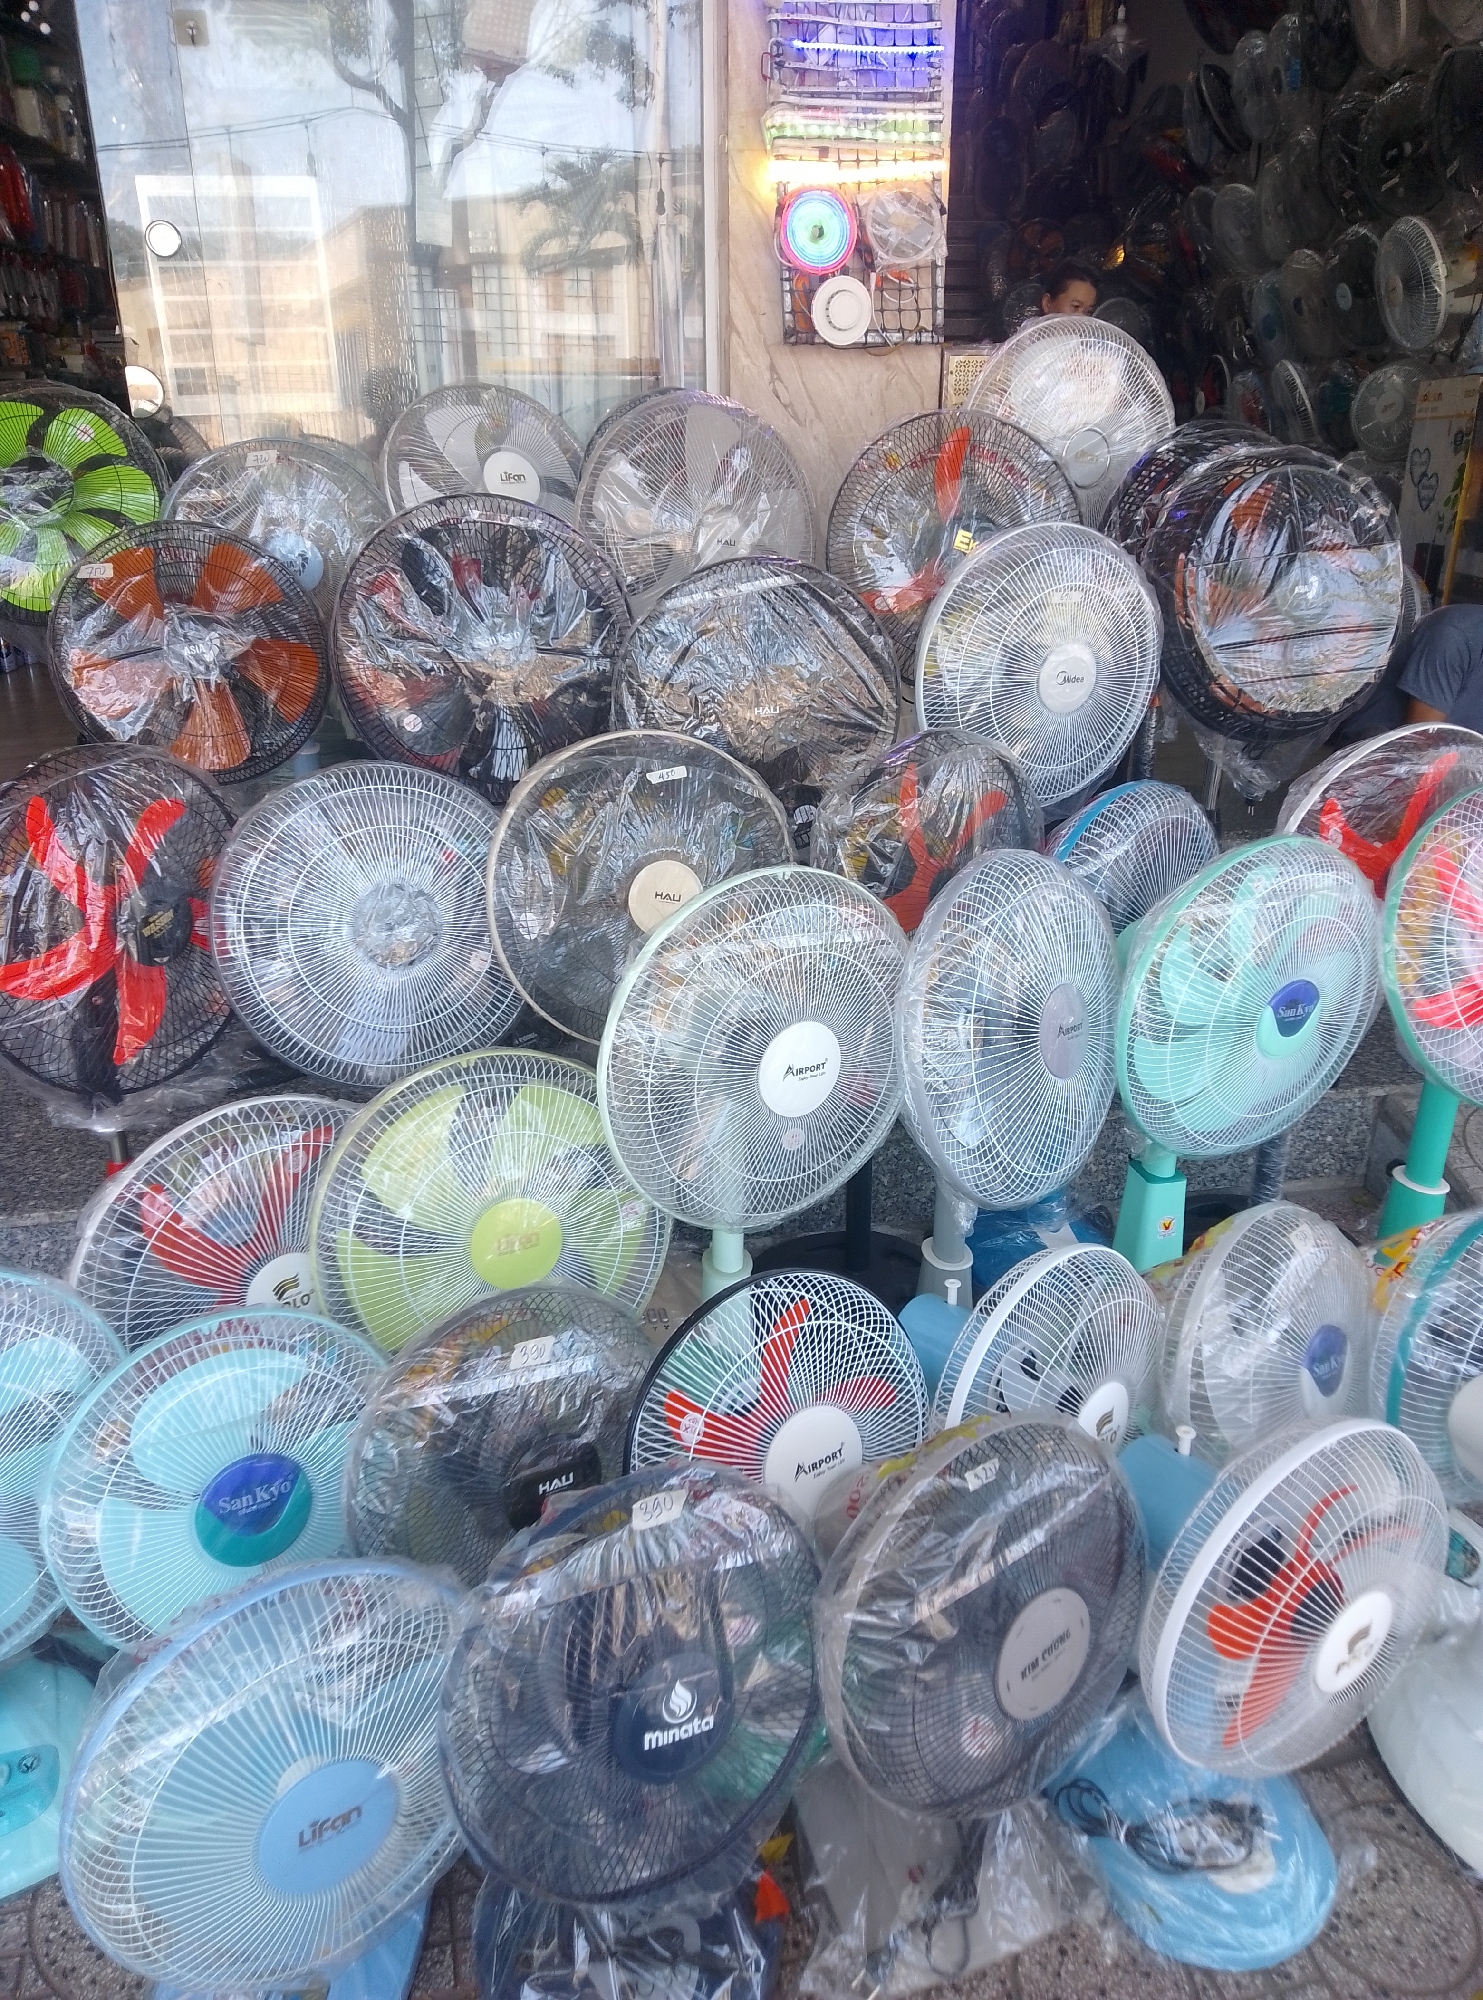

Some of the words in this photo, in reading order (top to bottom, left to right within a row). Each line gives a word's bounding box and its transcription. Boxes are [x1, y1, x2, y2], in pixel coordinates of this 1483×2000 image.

[500, 471, 526, 482] Lifan
[184, 643, 206, 656] ASIA
[658, 769, 676, 781] 450
[782, 1061, 827, 1082] AIRPORT
[520, 1344, 546, 1365] 390
[793, 1446, 843, 1483] AIRPORT
[640, 1494, 674, 1522] 390
[1020, 1656, 1040, 1681] KIM
[643, 1714, 715, 1751] minata
[298, 1805, 363, 1848] Lifan
